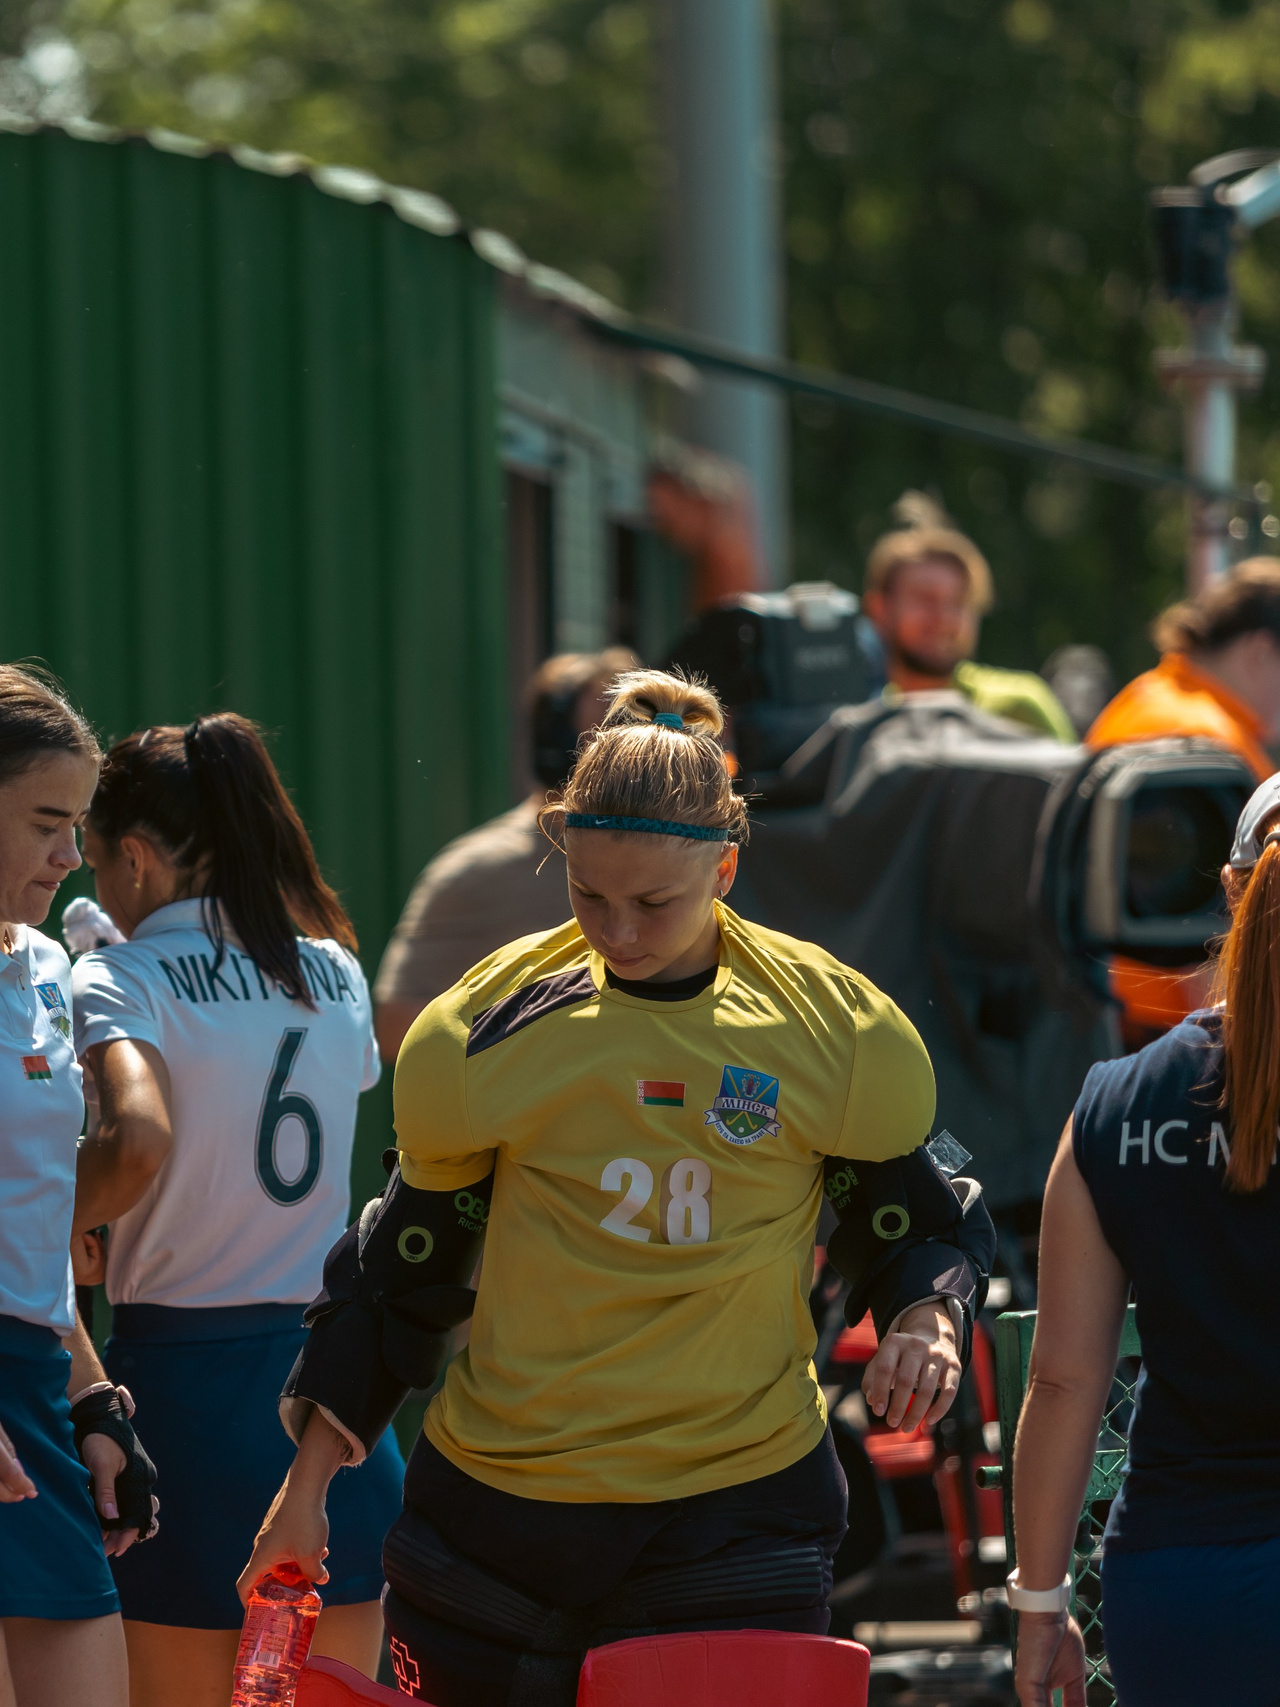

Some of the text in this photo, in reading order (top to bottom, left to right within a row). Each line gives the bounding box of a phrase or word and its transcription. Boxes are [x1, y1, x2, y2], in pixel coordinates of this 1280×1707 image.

[254, 1027, 324, 1208] 6
[1119, 1119, 1189, 1165] HC
[458, 1216, 483, 1234] RIGHT
[599, 1157, 713, 1246] 28
